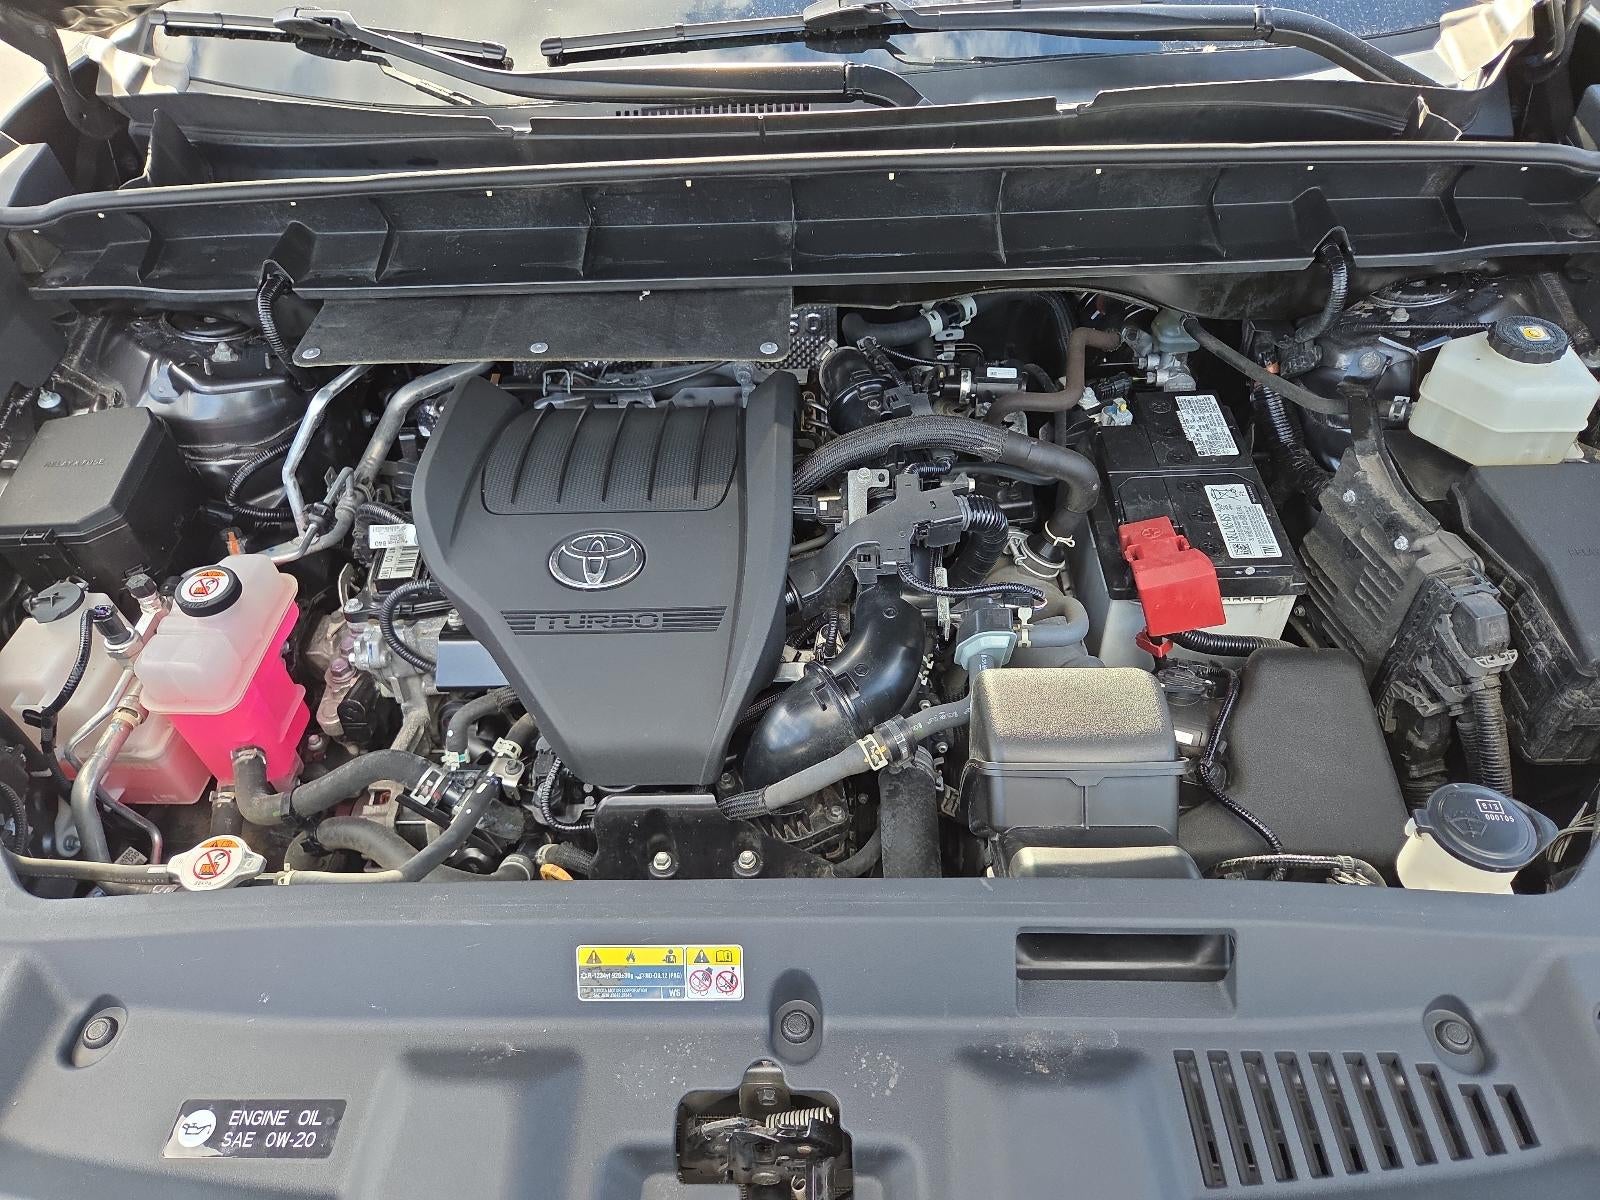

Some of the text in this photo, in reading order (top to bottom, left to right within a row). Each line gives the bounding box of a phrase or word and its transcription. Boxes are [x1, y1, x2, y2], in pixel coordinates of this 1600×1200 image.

[539, 612, 660, 630] TURBO
[1485, 813, 1515, 823] 000105
[228, 1110, 323, 1126] ENGINE OIL
[221, 1132, 317, 1148] SAE 0W-20
